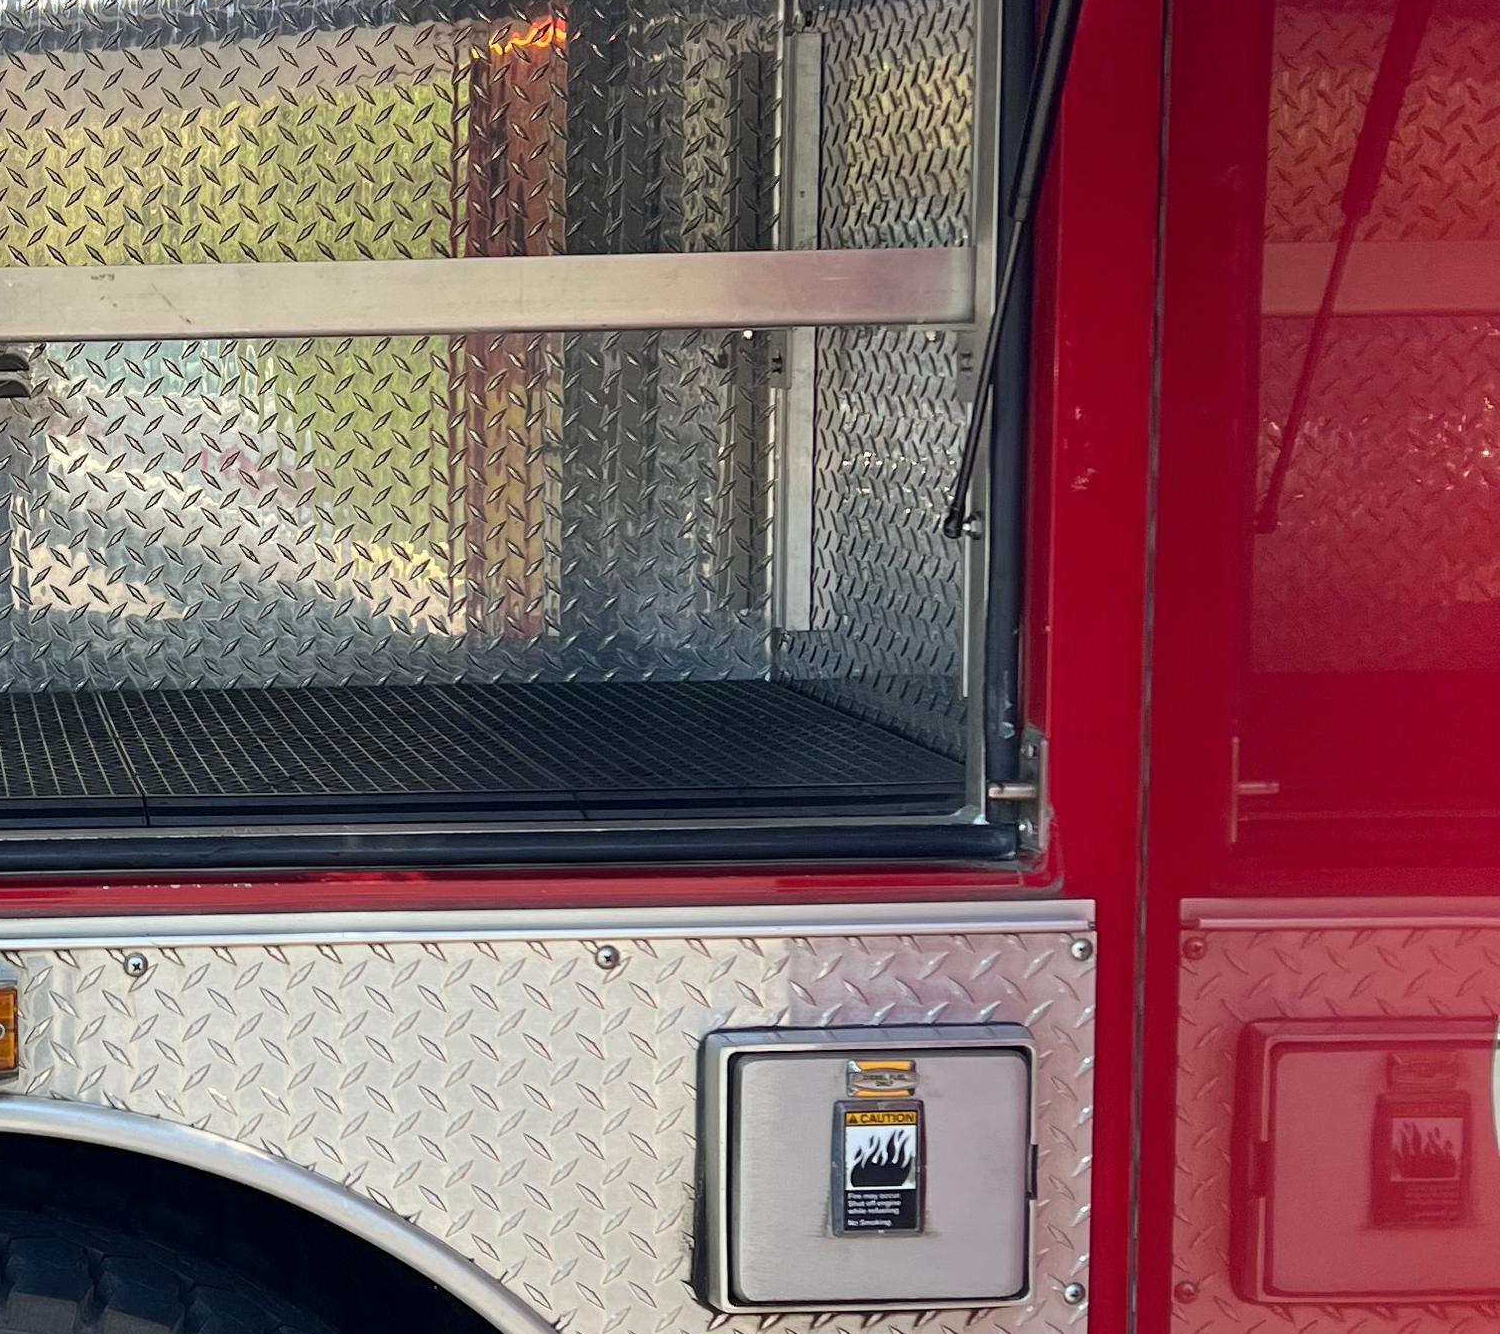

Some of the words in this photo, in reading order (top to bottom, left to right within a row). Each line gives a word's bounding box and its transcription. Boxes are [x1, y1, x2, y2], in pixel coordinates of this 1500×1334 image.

[859, 1112, 915, 1124] CAUTION
[847, 1192, 862, 1200] Fire
[862, 1193, 878, 1201] may
[877, 1200, 902, 1208] engine
[847, 1207, 867, 1215] while
